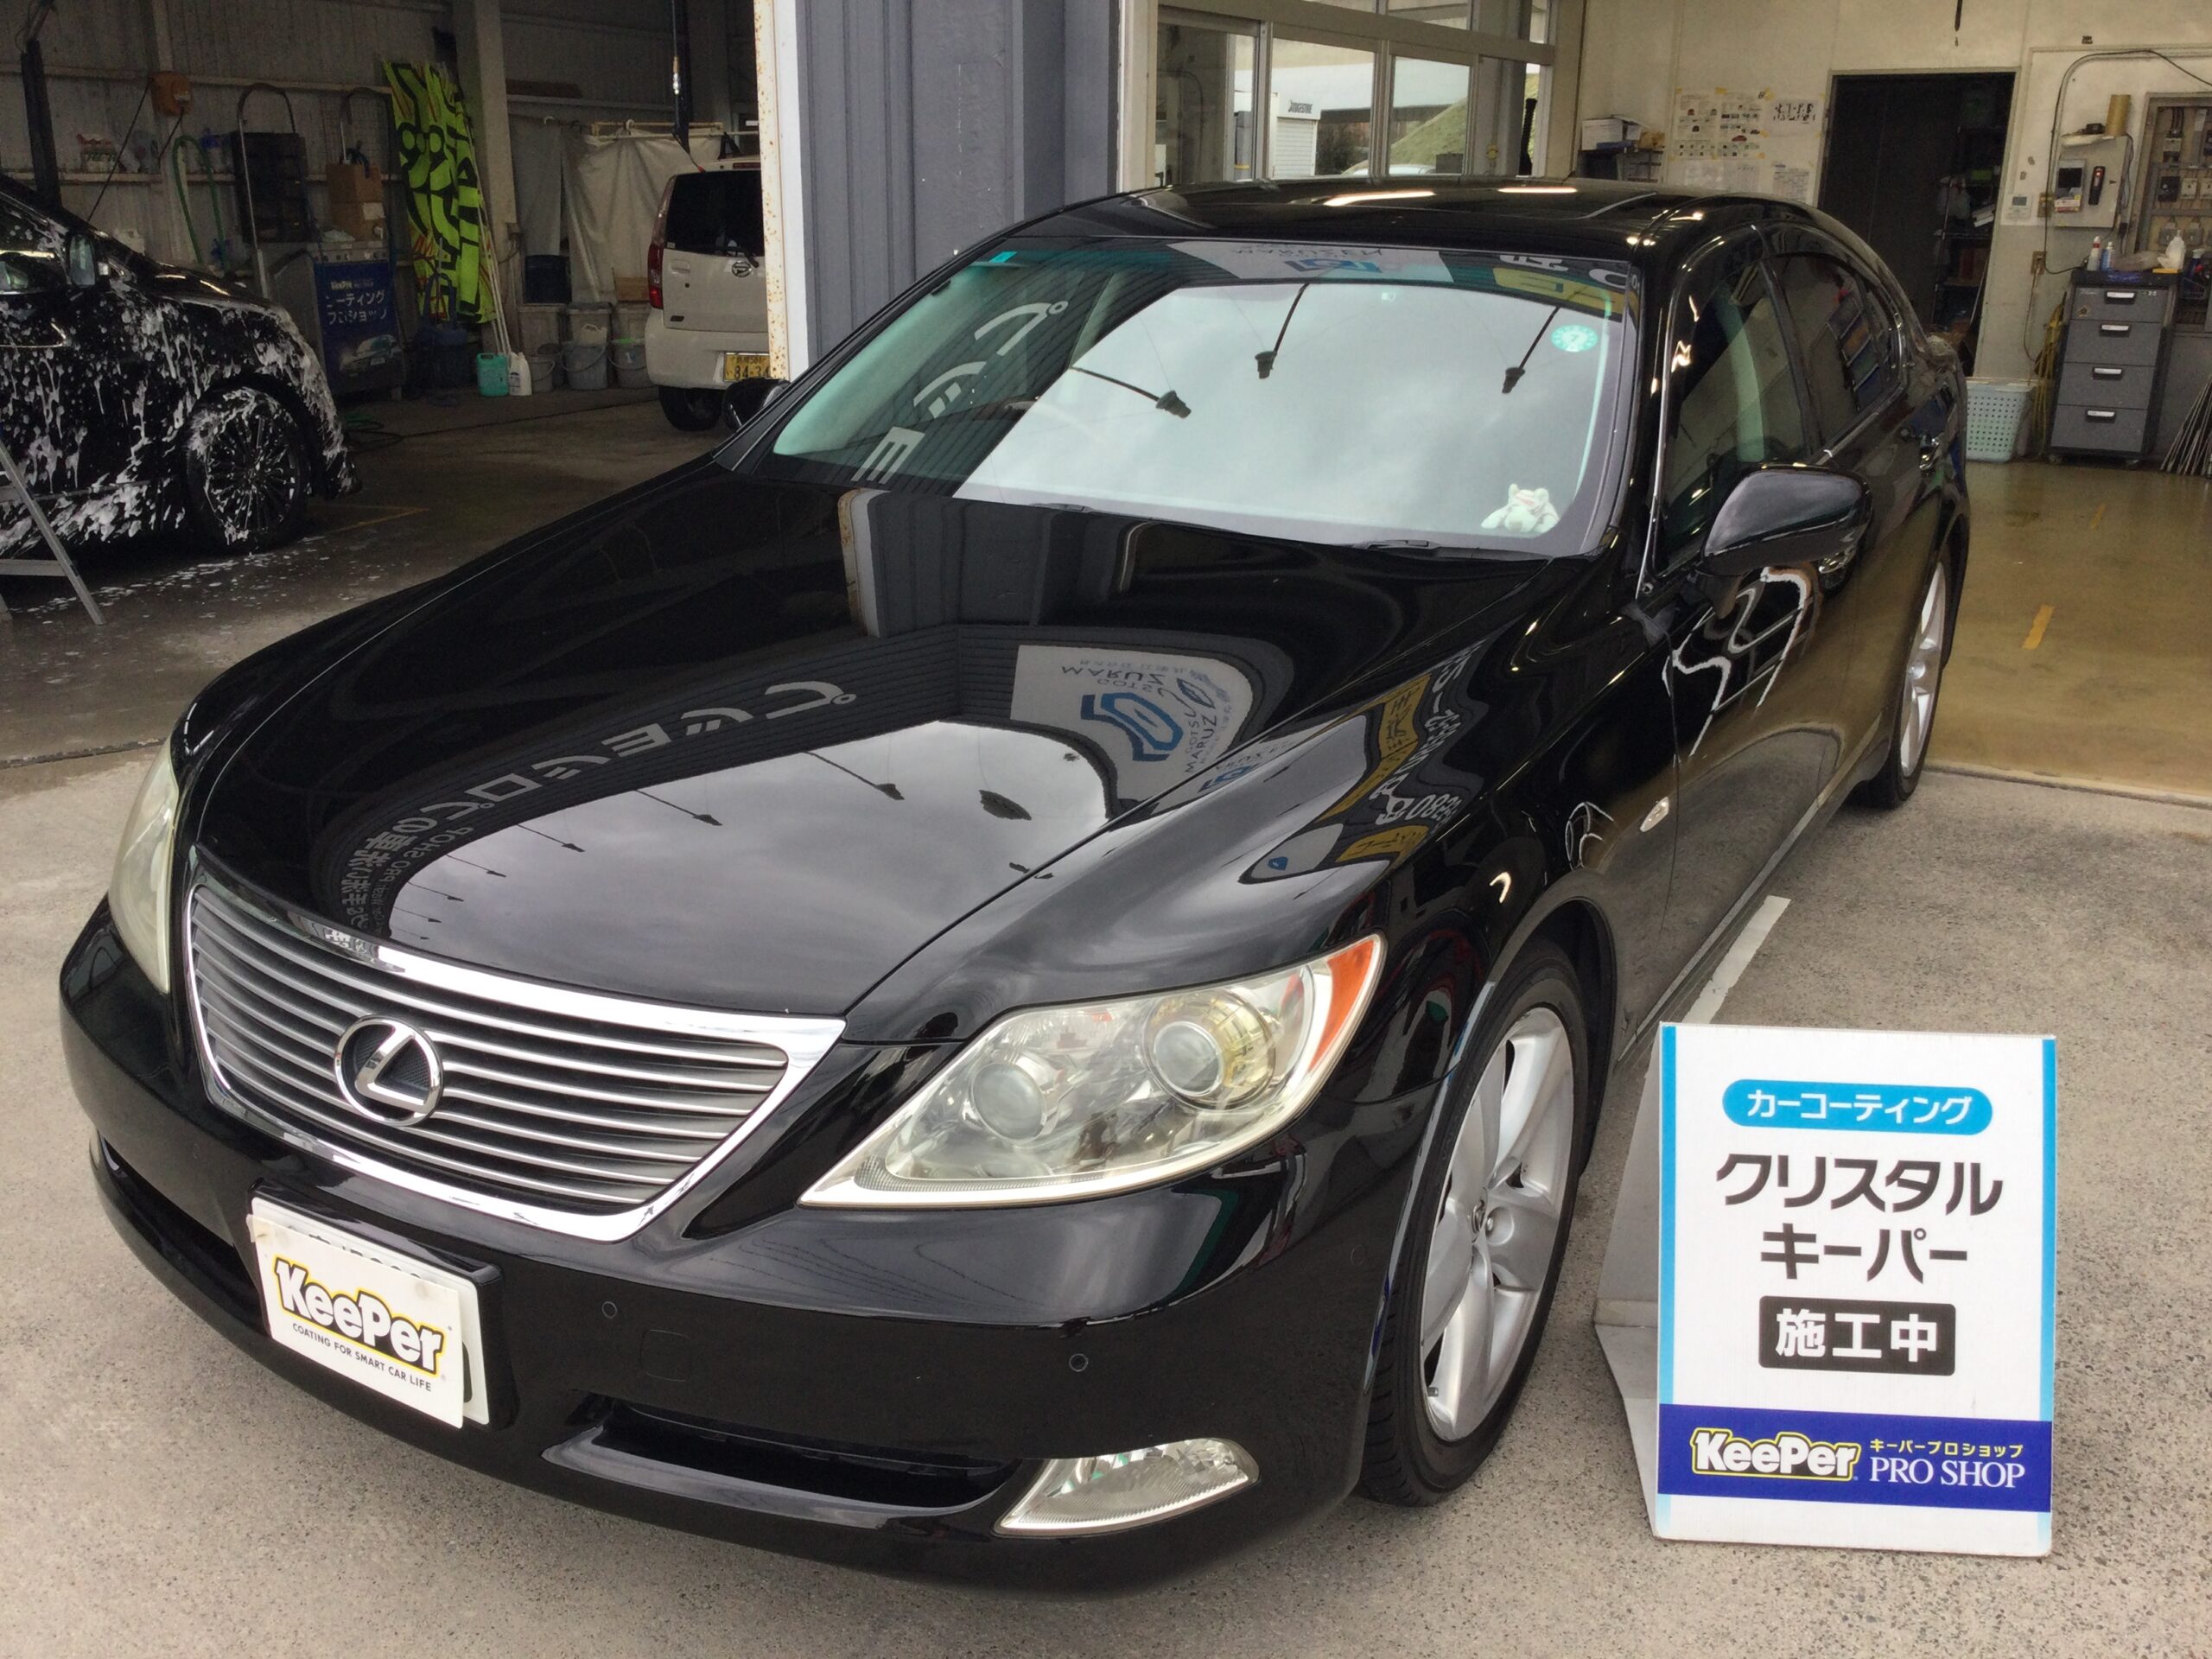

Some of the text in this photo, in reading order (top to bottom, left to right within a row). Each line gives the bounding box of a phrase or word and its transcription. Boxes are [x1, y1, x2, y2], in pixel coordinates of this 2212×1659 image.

[1746, 1088, 1973, 1126] カーコーティング
[1716, 1153, 2005, 1217] クリスタル
[1760, 1223, 1968, 1285] キーパー
[274, 1257, 445, 1376] KeePer
[1774, 1307, 1938, 1363] 施工中
[291, 1322, 432, 1392] COATING FOR SMART CAR LIFE
[1690, 1427, 2025, 1488] KeePer PRO SHOP
[1869, 1438, 2024, 1459] キーパープロショップ
